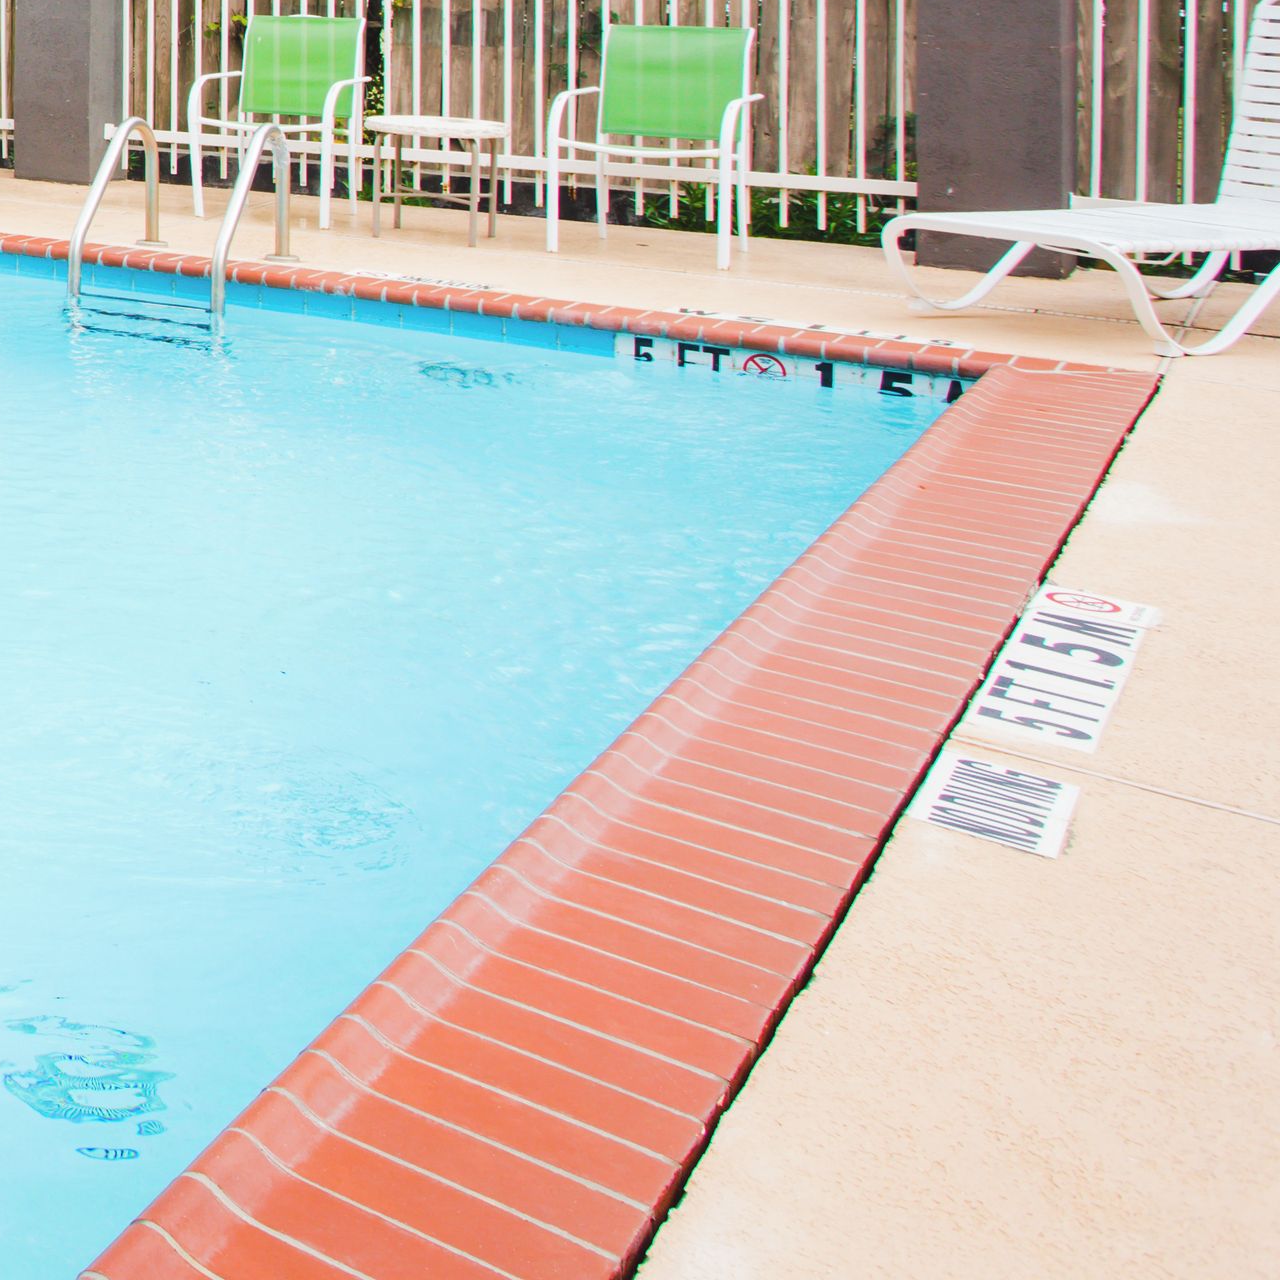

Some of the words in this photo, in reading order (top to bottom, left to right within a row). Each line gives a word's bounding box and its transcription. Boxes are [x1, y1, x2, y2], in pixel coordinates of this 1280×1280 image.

[634, 337, 654, 362] 5
[677, 342, 730, 371] FT
[938, 759, 1063, 829] DIVING
